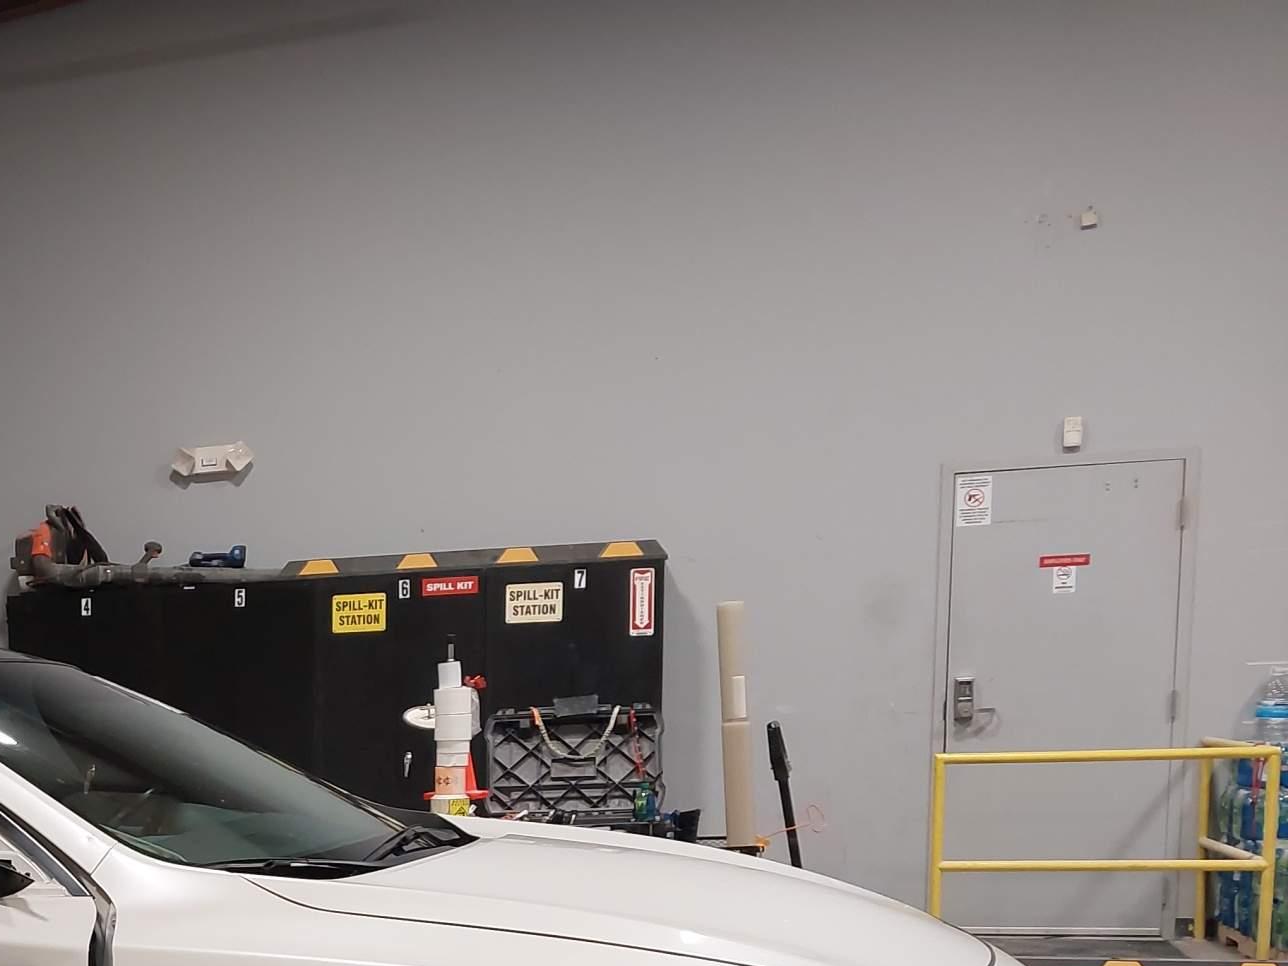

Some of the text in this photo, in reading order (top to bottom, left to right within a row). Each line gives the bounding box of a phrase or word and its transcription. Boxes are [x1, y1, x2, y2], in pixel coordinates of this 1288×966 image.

[425, 580, 474, 592] SPILL KIT
[509, 589, 561, 602] SPILL-KIT
[336, 599, 384, 612] SPILL-KIT
[513, 603, 556, 616] STATION
[339, 613, 380, 626] STATION
